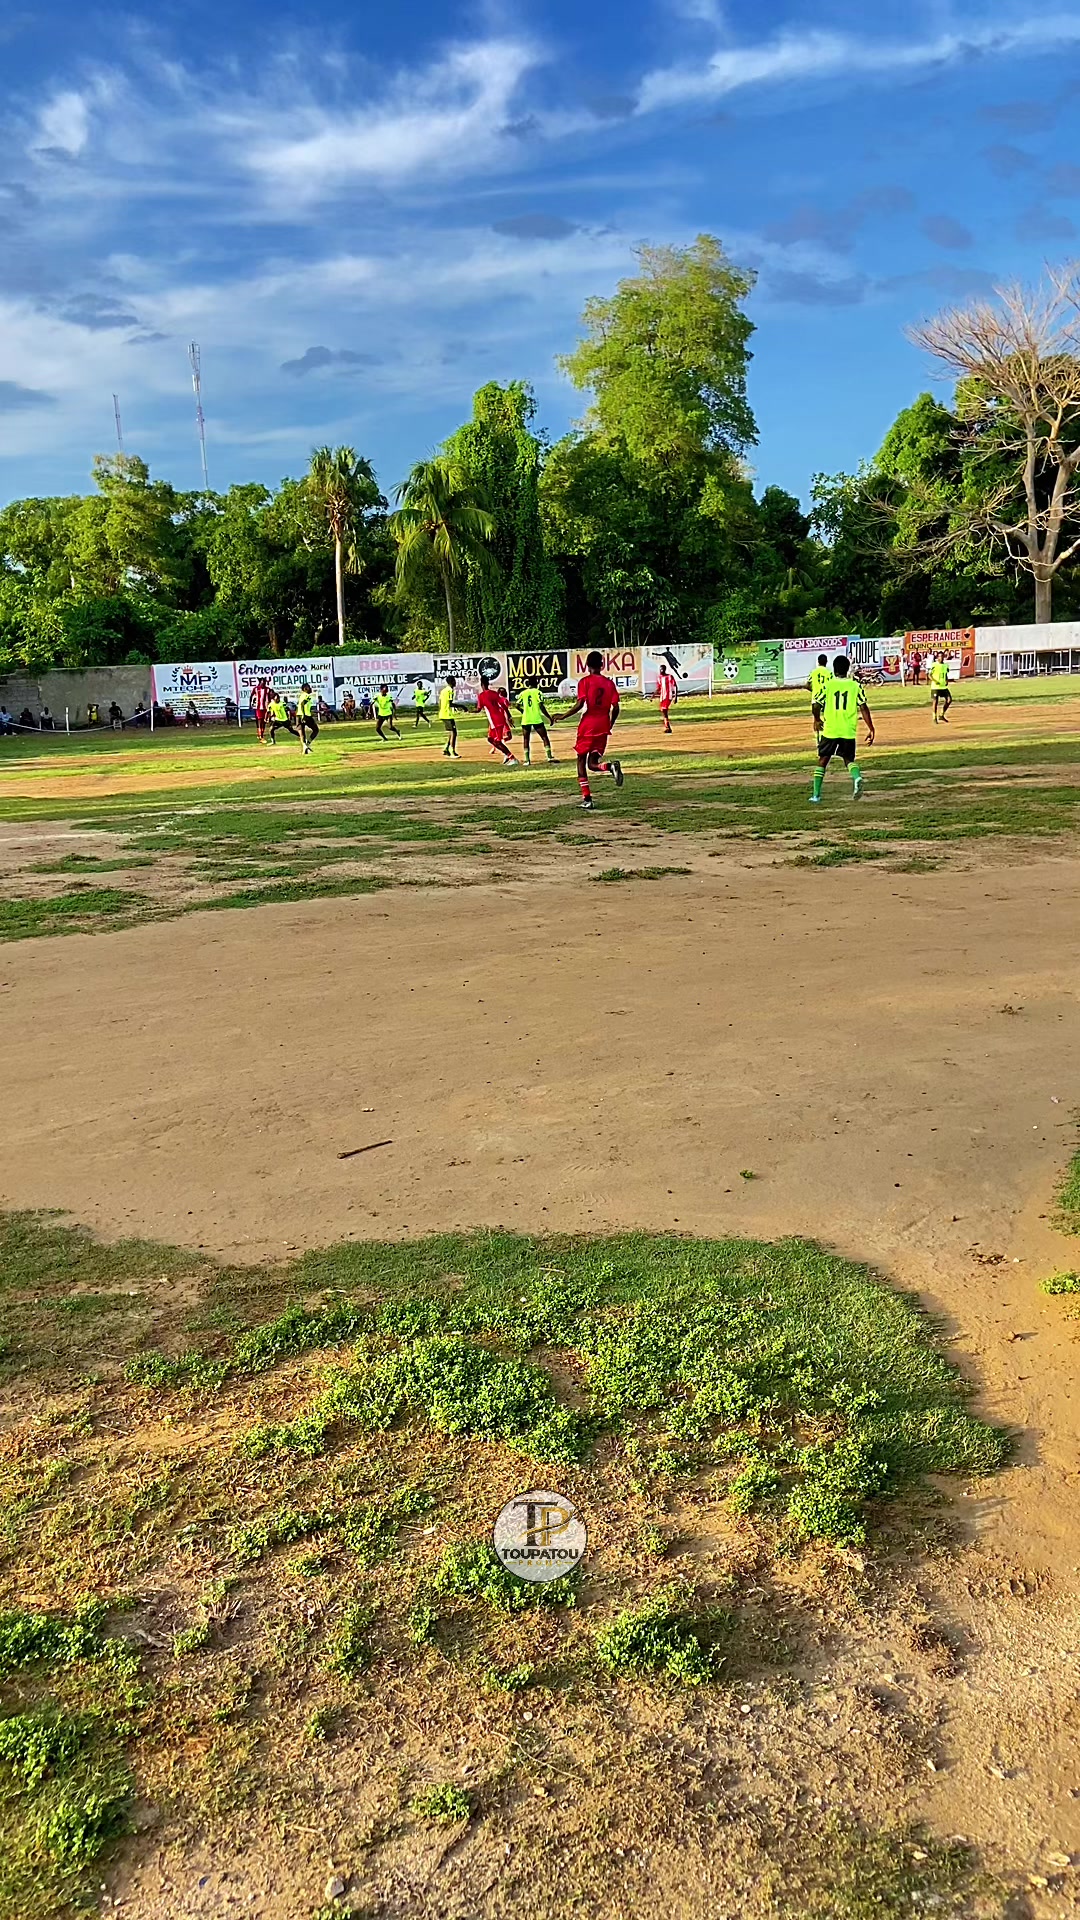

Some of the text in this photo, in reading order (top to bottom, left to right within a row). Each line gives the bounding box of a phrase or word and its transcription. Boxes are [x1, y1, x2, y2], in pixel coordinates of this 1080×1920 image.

[911, 631, 961, 643] ESPERANCE
[785, 638, 843, 649] OPEN SPONSORS
[238, 663, 307, 676] Entreprises
[359, 659, 400, 671] ROSE
[436, 659, 474, 670] FESTI
[508, 654, 563, 678] MOKA
[343, 674, 408, 686] MATERIAUX DE
[527, 695, 533, 707] 6
[833, 690, 849, 711] 11
